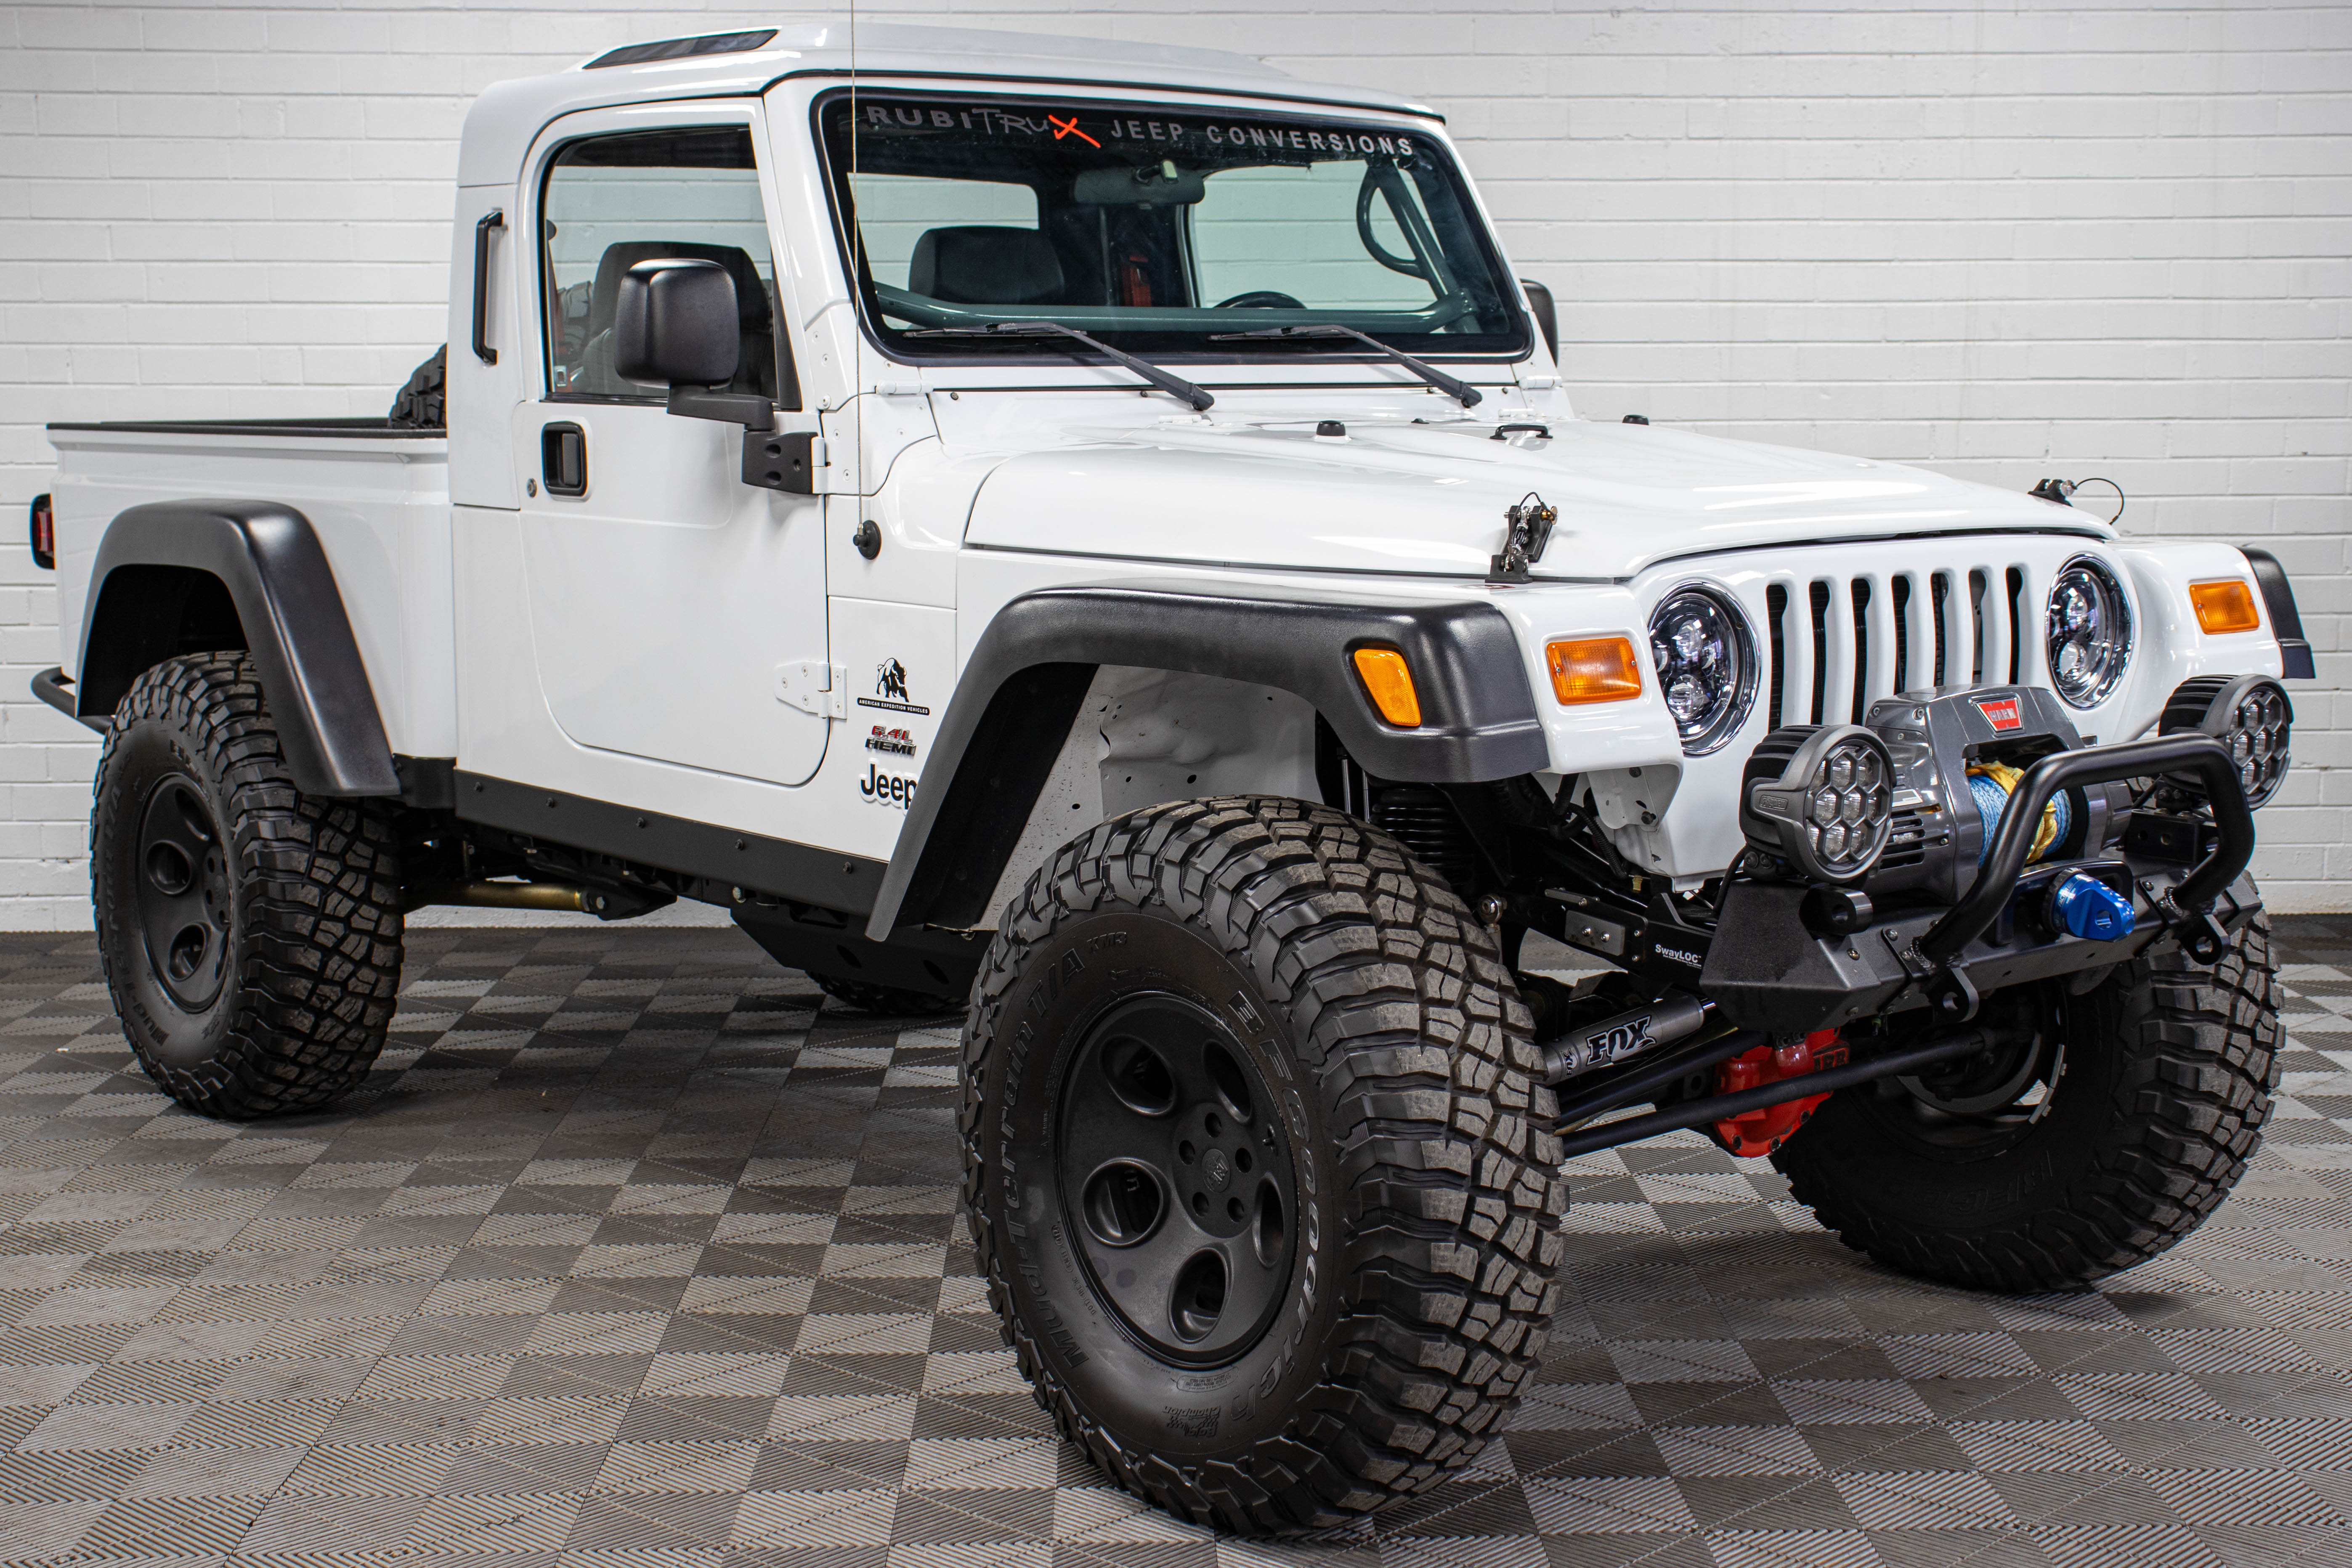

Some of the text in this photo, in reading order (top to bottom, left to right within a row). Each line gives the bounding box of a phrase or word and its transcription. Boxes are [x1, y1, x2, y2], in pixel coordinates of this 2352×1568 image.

[1111, 119, 1183, 141] JEEP
[1206, 125, 1413, 155] CONVERSIONS
[865, 737, 916, 756] HEMI
[872, 725, 913, 742] 6.4L
[861, 763, 917, 810] Jeep
[1655, 944, 1699, 963] SwayLOC
[1586, 1014, 1656, 1066] FOX
